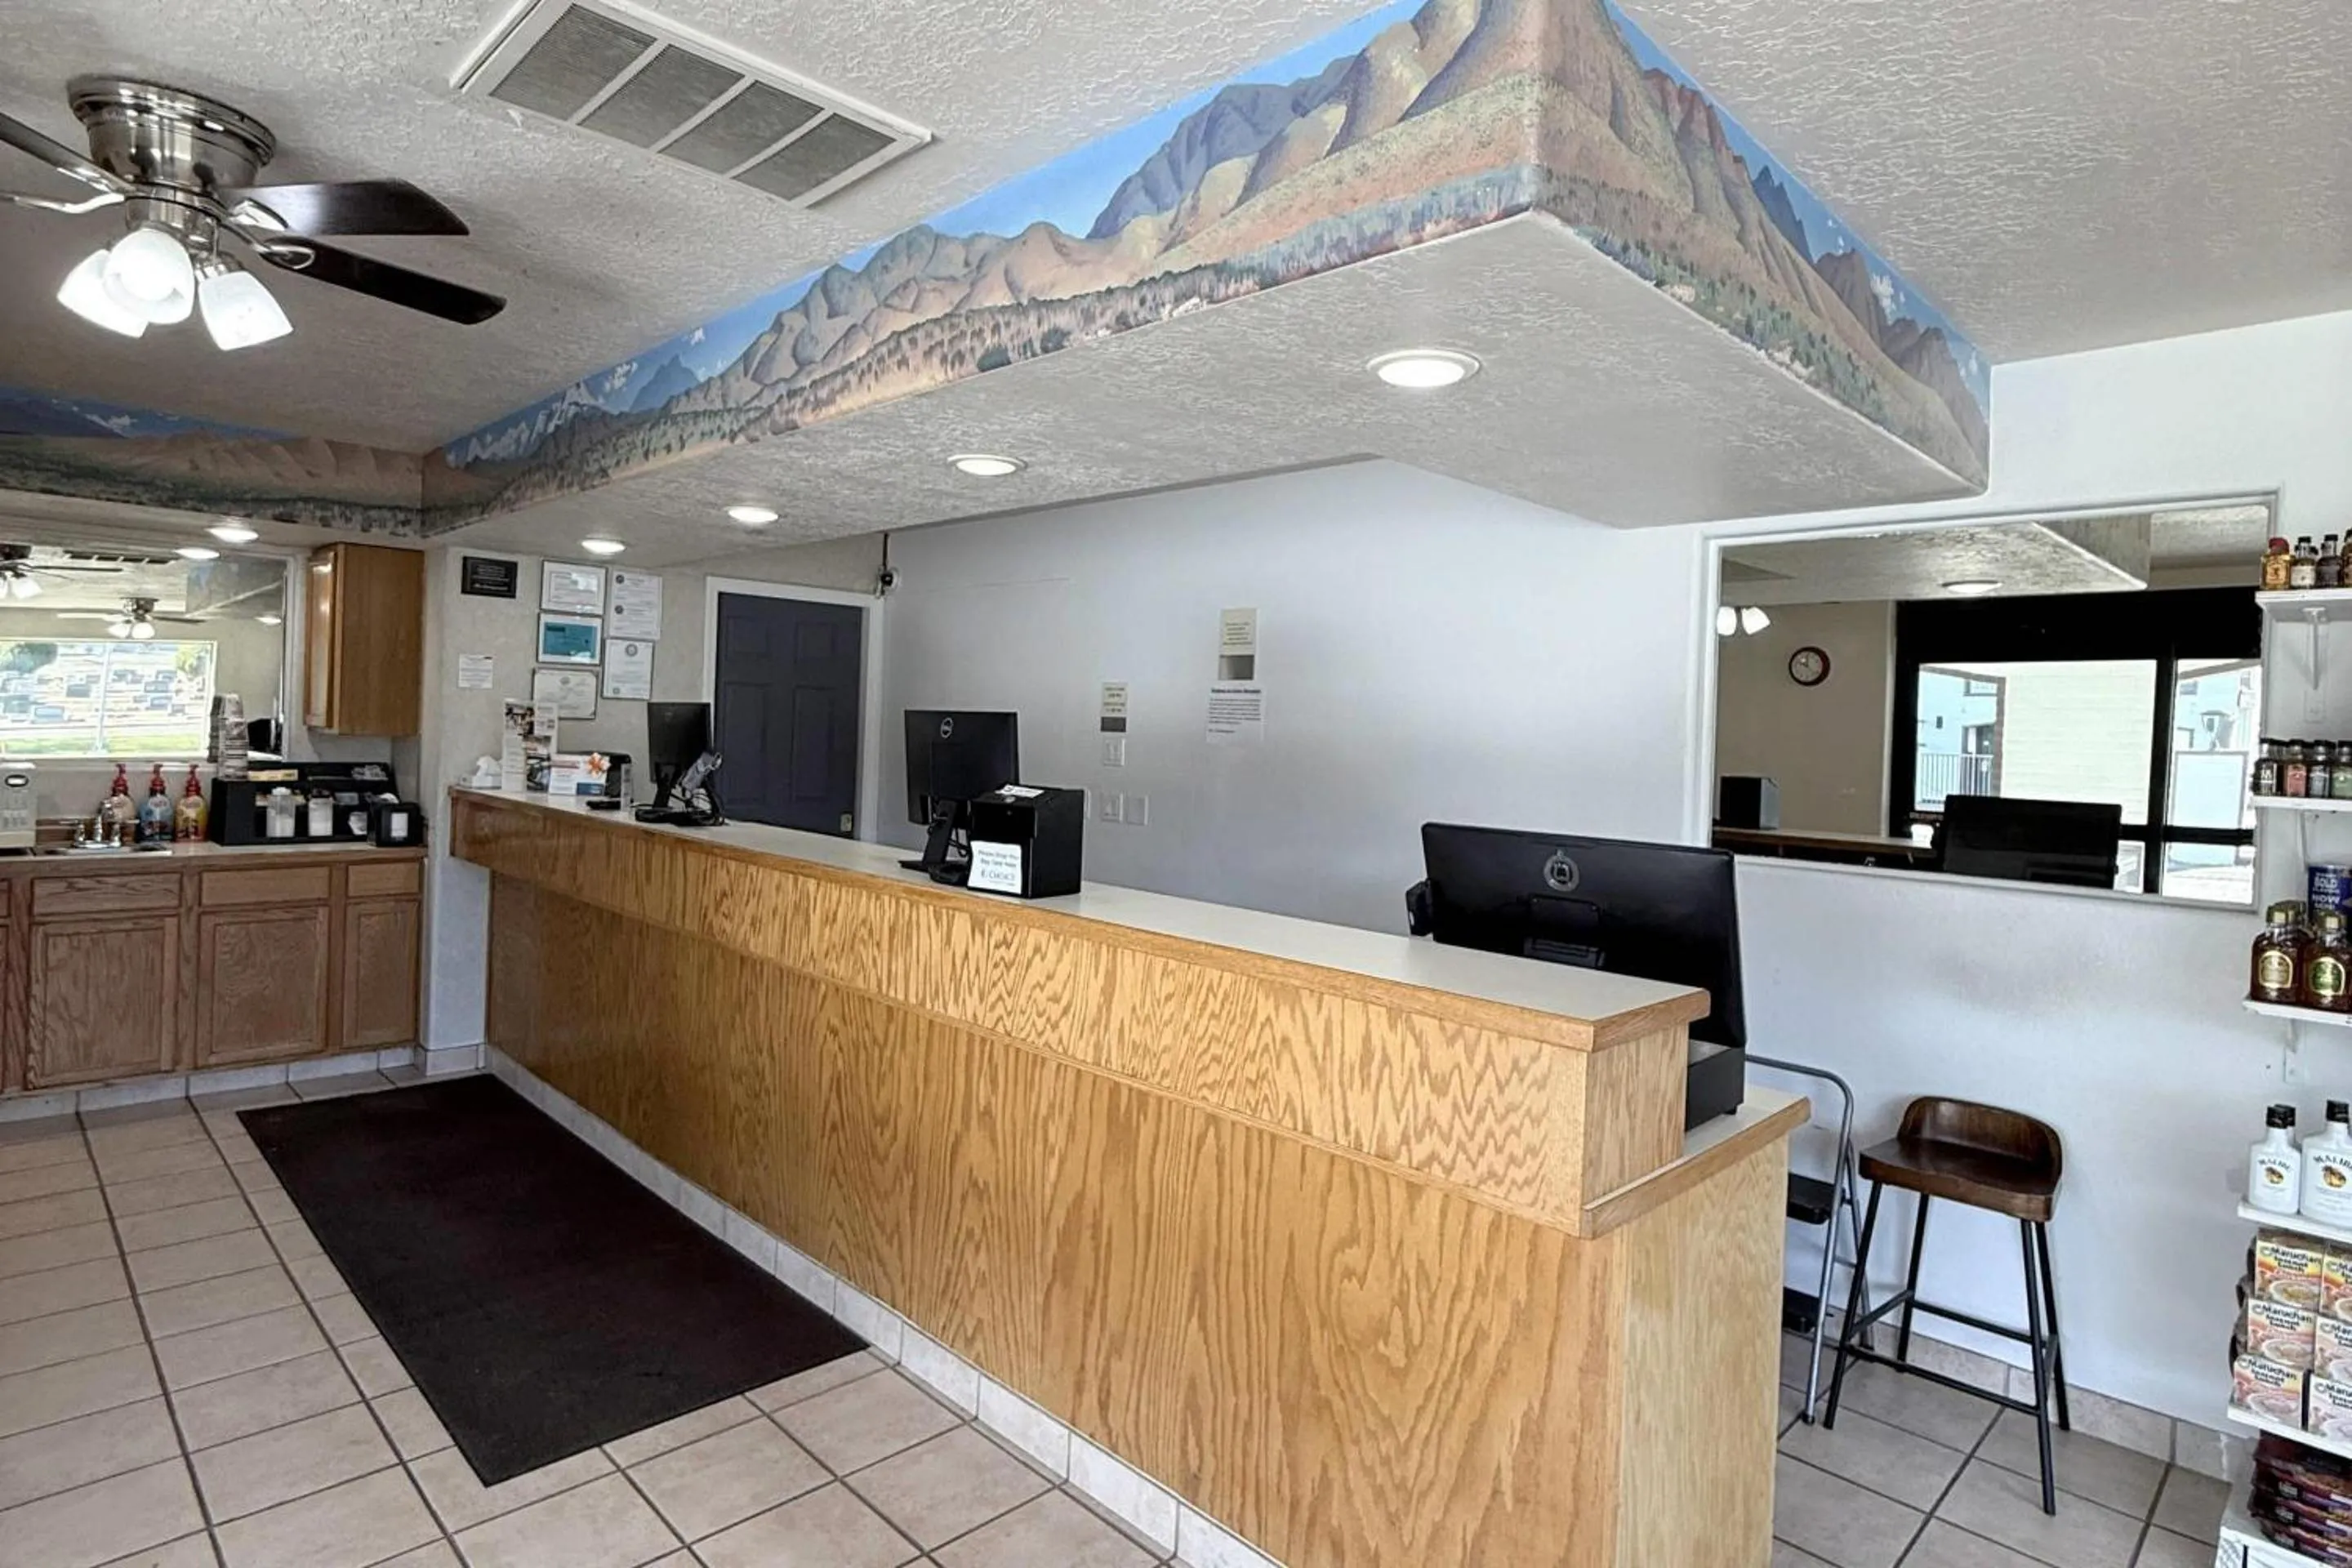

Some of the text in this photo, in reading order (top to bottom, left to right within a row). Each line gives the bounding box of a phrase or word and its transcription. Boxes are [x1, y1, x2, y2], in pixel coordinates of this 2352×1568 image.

[2271, 1246, 2322, 1263] Maruchan
[2262, 1304, 2312, 1323] Maruchan
[2247, 1358, 2297, 1380] Maruchan
